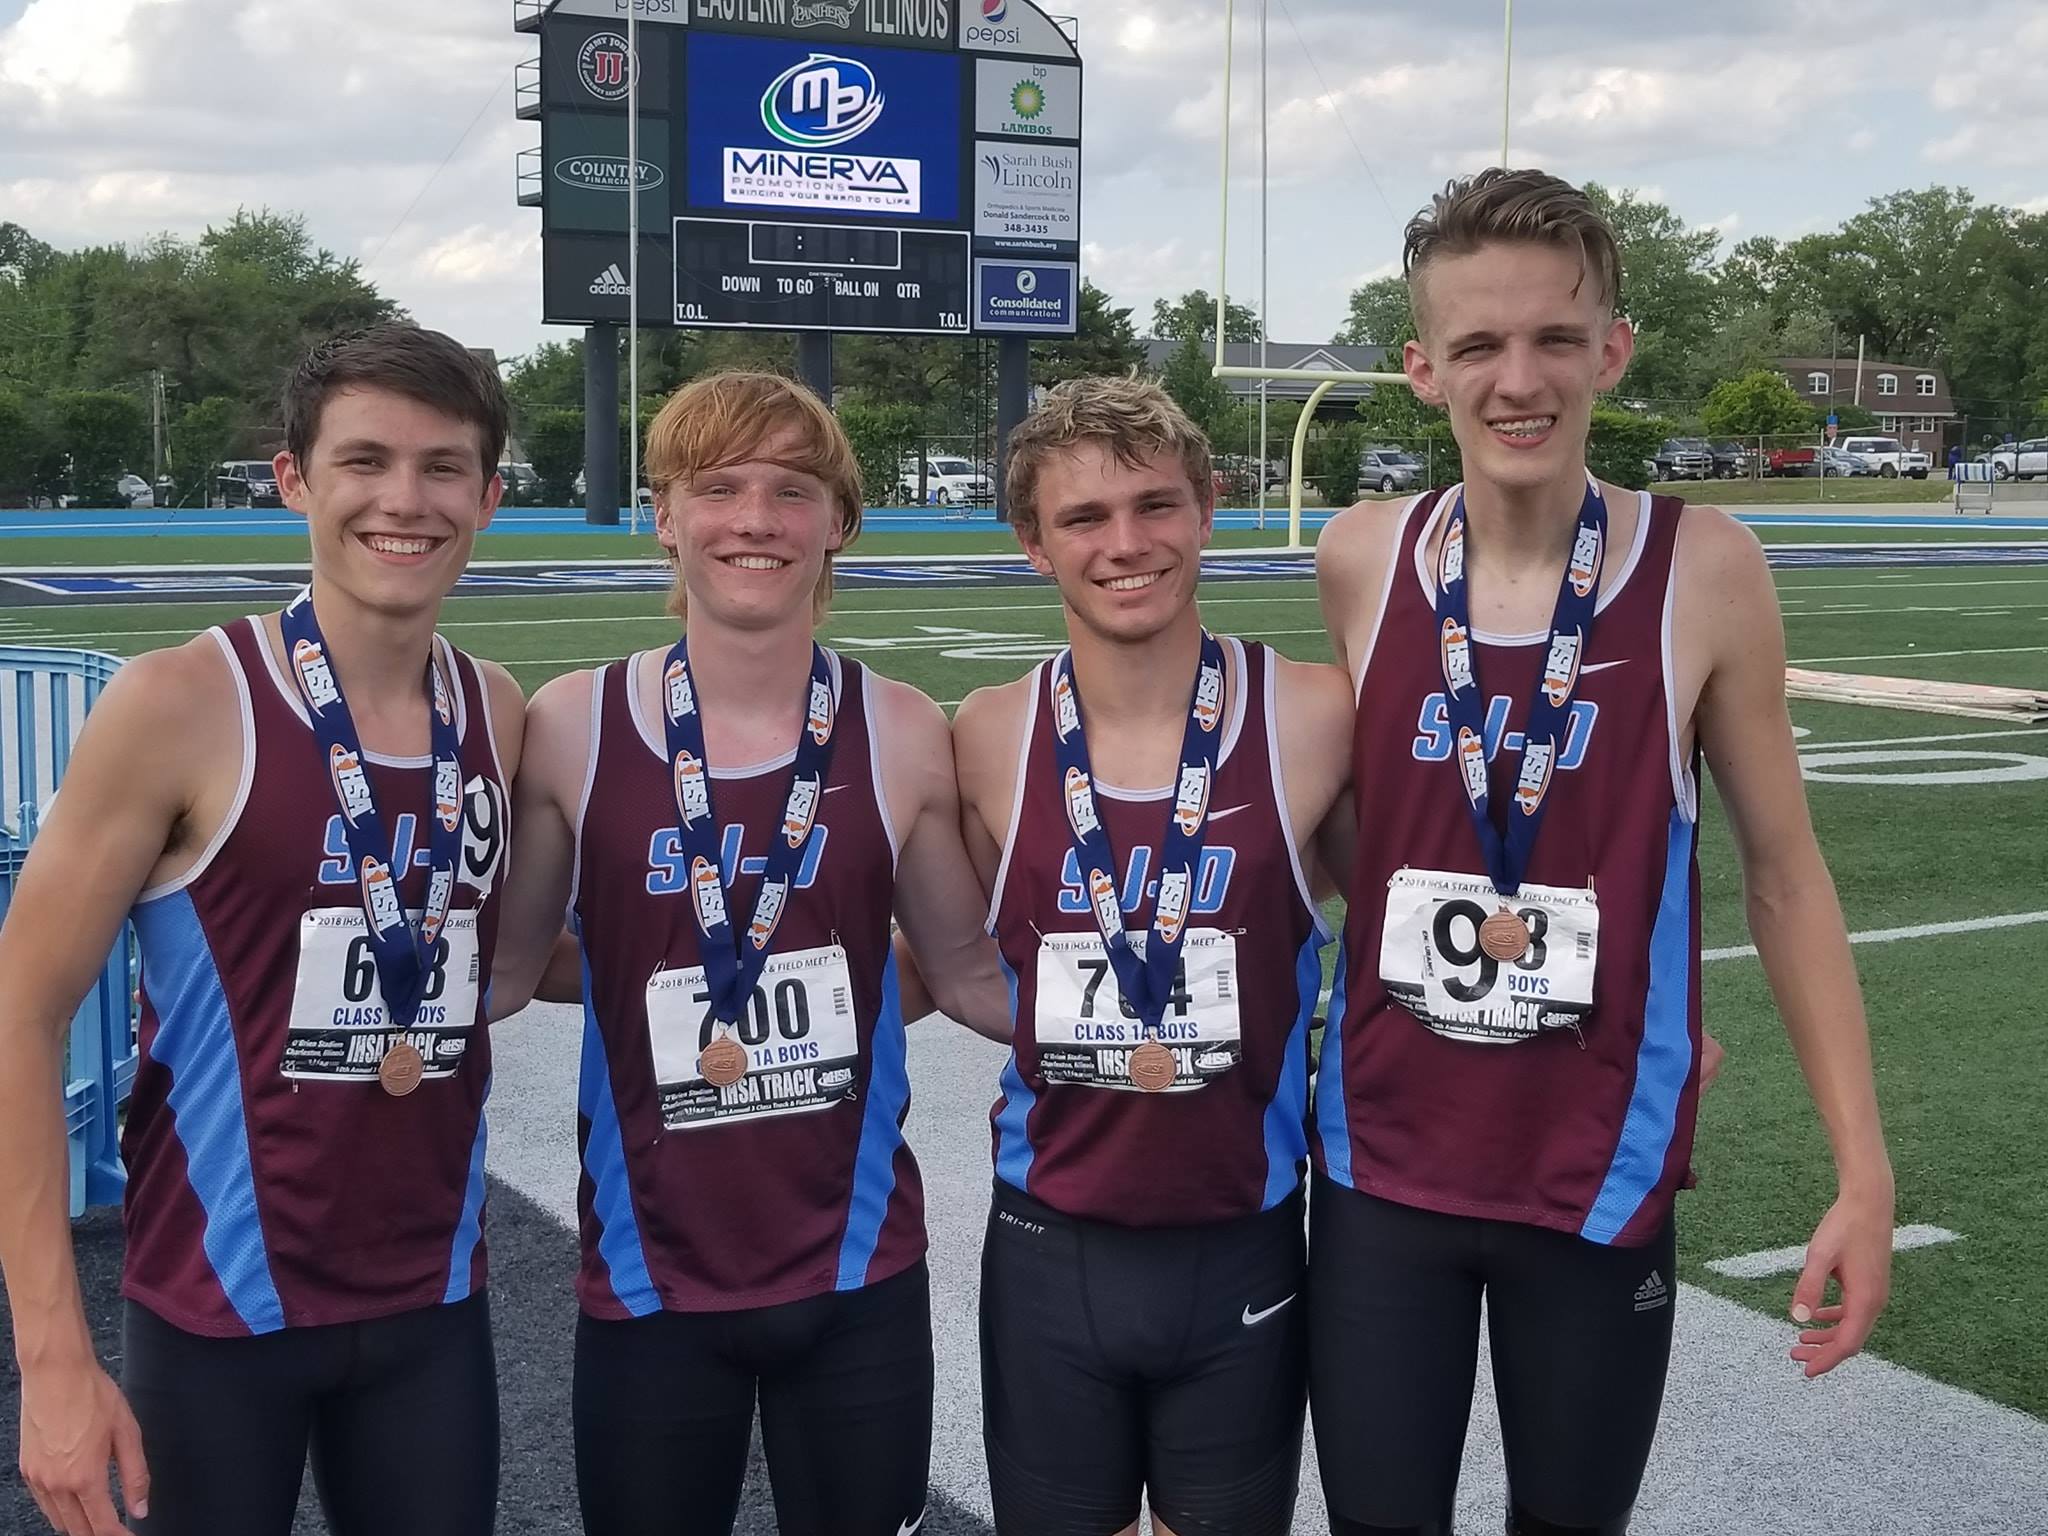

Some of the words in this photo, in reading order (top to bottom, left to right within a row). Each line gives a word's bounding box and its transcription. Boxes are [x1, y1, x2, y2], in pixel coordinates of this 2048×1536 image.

[796, 4, 849, 25] PANTHERS
[865, 0, 949, 39] ILLINOIS
[966, 26, 1019, 45] pepsi
[582, 37, 607, 61] JIMMY
[595, 51, 623, 84] JJ
[1032, 65, 1047, 79] bp
[1001, 123, 1052, 135] LAMBOS
[1002, 154, 1036, 167] Sarah
[1042, 156, 1072, 169] Bush
[585, 176, 629, 185] FINANCIA
[732, 177, 844, 191] PROMOTIONS
[1003, 169, 1072, 189] Lincoln
[730, 188, 784, 198] BRINGING
[790, 192, 819, 200] YOUR
[825, 194, 862, 202] BRAND
[885, 197, 911, 205] LIFE
[983, 211, 1008, 219] Donald
[1010, 212, 1049, 221] Sandercock
[1004, 224, 1048, 234] 348-3435
[994, 240, 1057, 250] www.sarahbush.org
[721, 276, 760, 293] DOWN
[777, 278, 793, 294] TO
[796, 279, 813, 295] GO
[835, 280, 862, 296] BALL
[863, 281, 879, 297] ON
[896, 283, 921, 298] QTR
[677, 303, 708, 320] T.O.L.
[990, 297, 1061, 310] Consolidated
[938, 312, 967, 328] T.O.L.
[989, 309, 1061, 318] communications
[1404, 878, 1426, 888] 2018
[1451, 883, 1480, 894] STATE
[318, 917, 341, 927] 2018
[343, 917, 364, 927] IHSA
[455, 918, 475, 928] MEET
[1071, 941, 1090, 950] IHSA
[1191, 938, 1216, 947] MEET
[660, 978, 683, 989] 2018
[684, 975, 706, 986] IHSA
[769, 962, 775, 973] &
[778, 961, 803, 972] FIELD
[805, 956, 828, 968] MEET
[1508, 975, 1550, 995] BOYS
[333, 1006, 383, 1025] CLASS
[417, 1006, 446, 1023] OYS
[1075, 1024, 1125, 1040] CLASS
[1158, 1022, 1198, 1040] BOYS
[345, 1034, 384, 1063] IHSA
[754, 1049, 774, 1067] 1A
[779, 1042, 820, 1063] BOYS
[720, 1076, 760, 1106] IHSA
[761, 1067, 817, 1099] TRACK
[998, 1210, 1045, 1235] DRI-FIT
